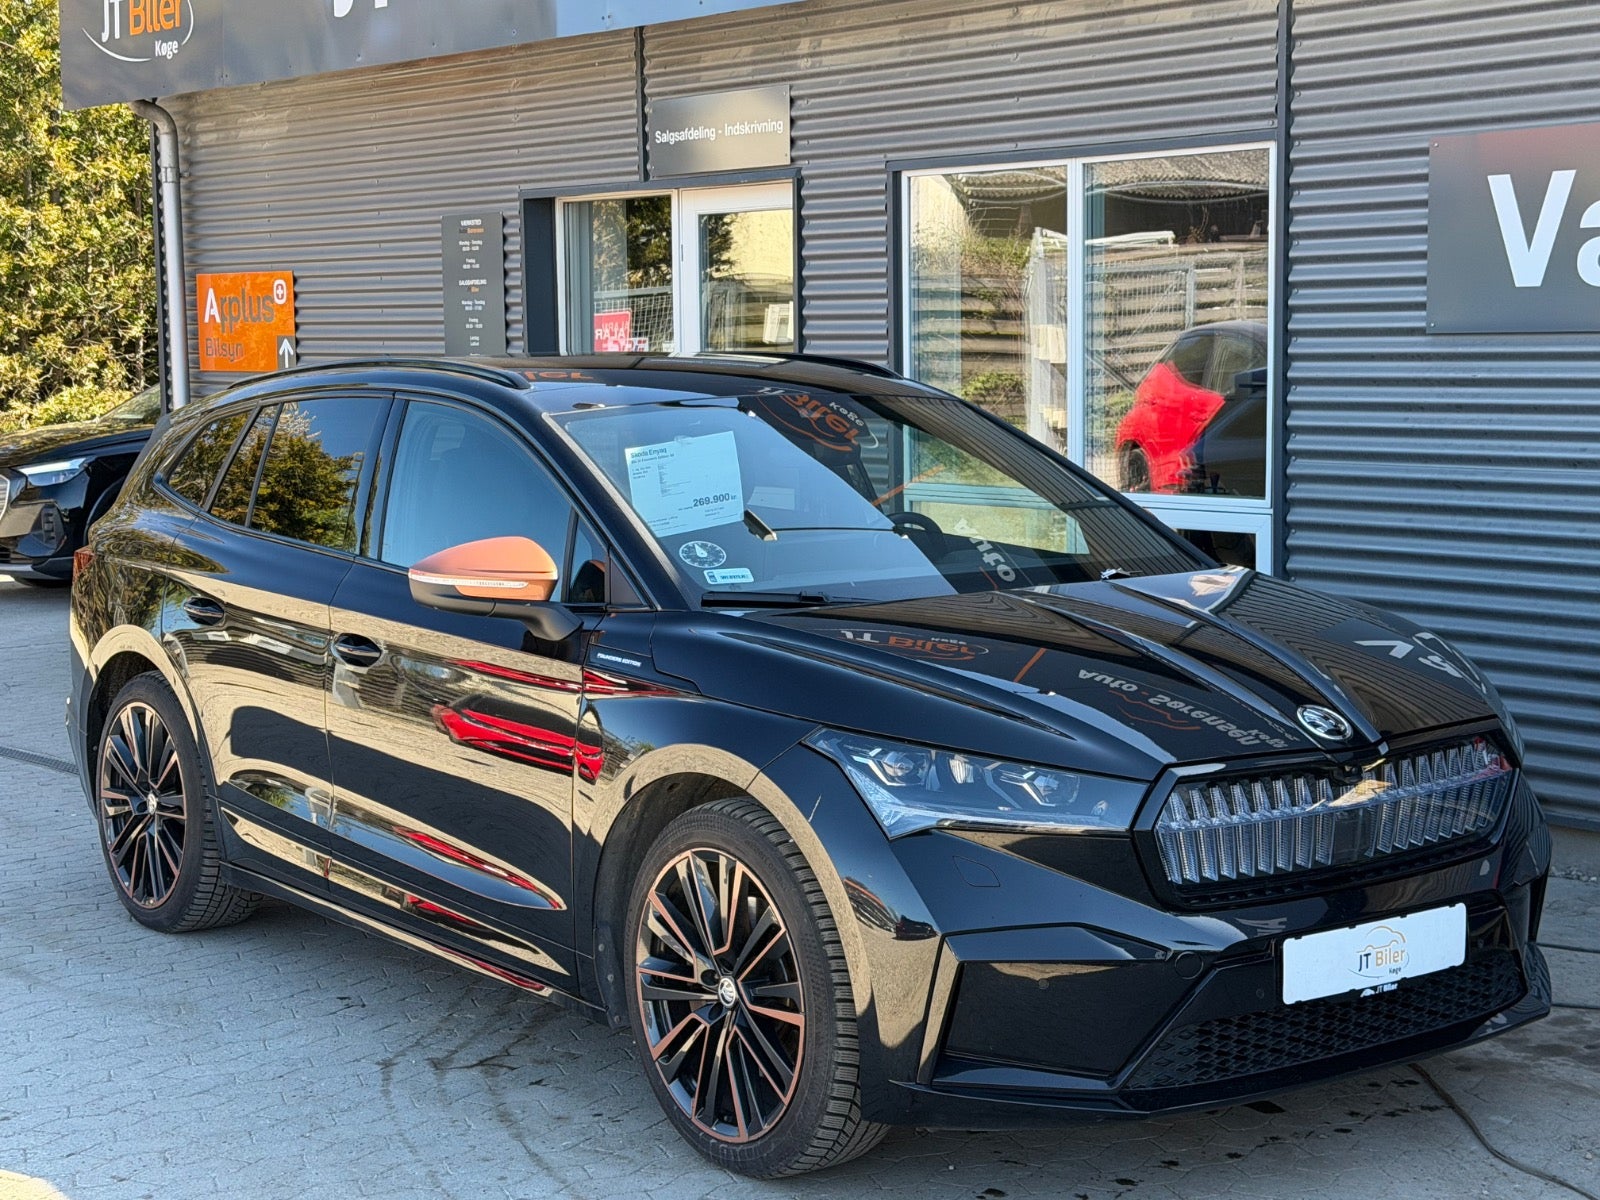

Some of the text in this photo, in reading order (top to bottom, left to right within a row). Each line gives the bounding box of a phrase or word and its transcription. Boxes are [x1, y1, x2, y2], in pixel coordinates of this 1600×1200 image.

[155, 40, 179, 60] Køge
[655, 126, 716, 145] Salgsafdeling
[724, 119, 784, 137] Indskrivning
[205, 337, 243, 362] Bilsyn
[692, 492, 730, 508] 269.900
[1358, 947, 1406, 972] JT Biler
